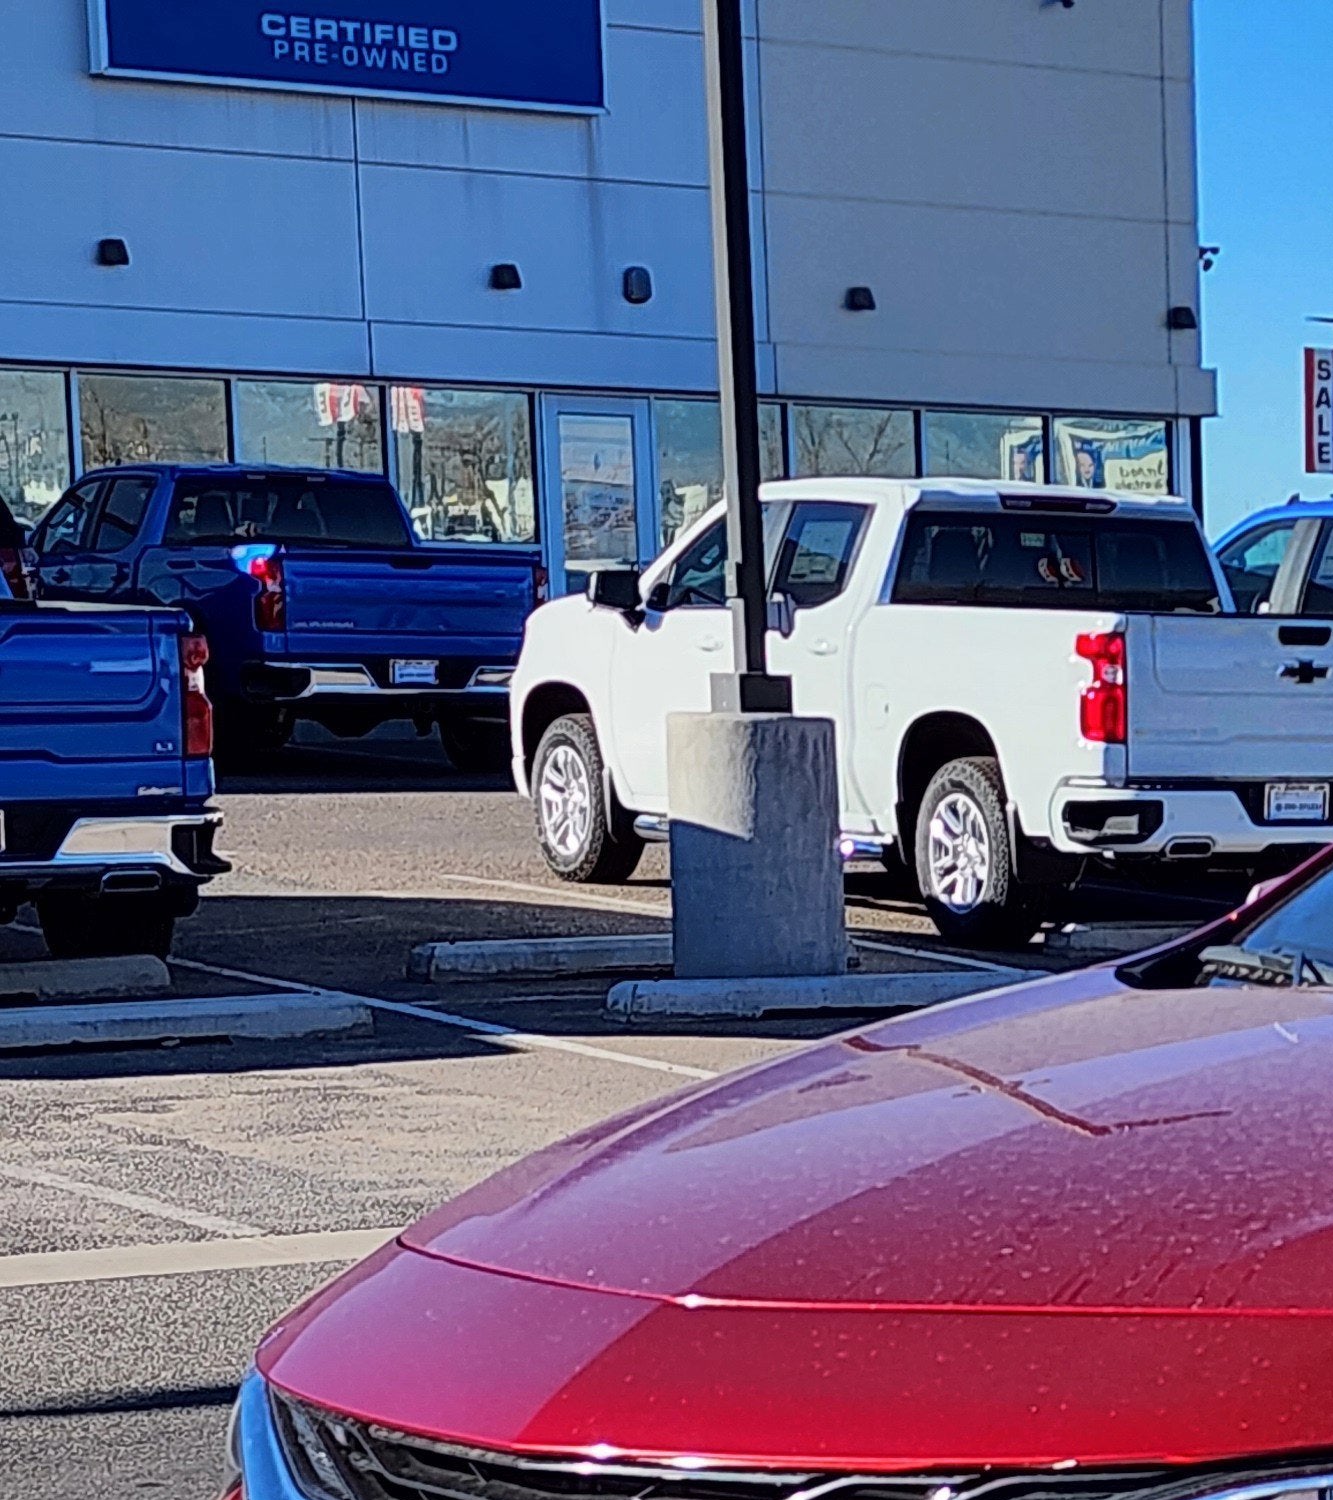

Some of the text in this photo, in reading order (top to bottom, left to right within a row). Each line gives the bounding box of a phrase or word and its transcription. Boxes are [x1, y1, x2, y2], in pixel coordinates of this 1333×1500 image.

[261, 13, 457, 51] CERTIFIED
[274, 39, 448, 74] PRE-OWNED
[1315, 359, 1332, 464] SALE
